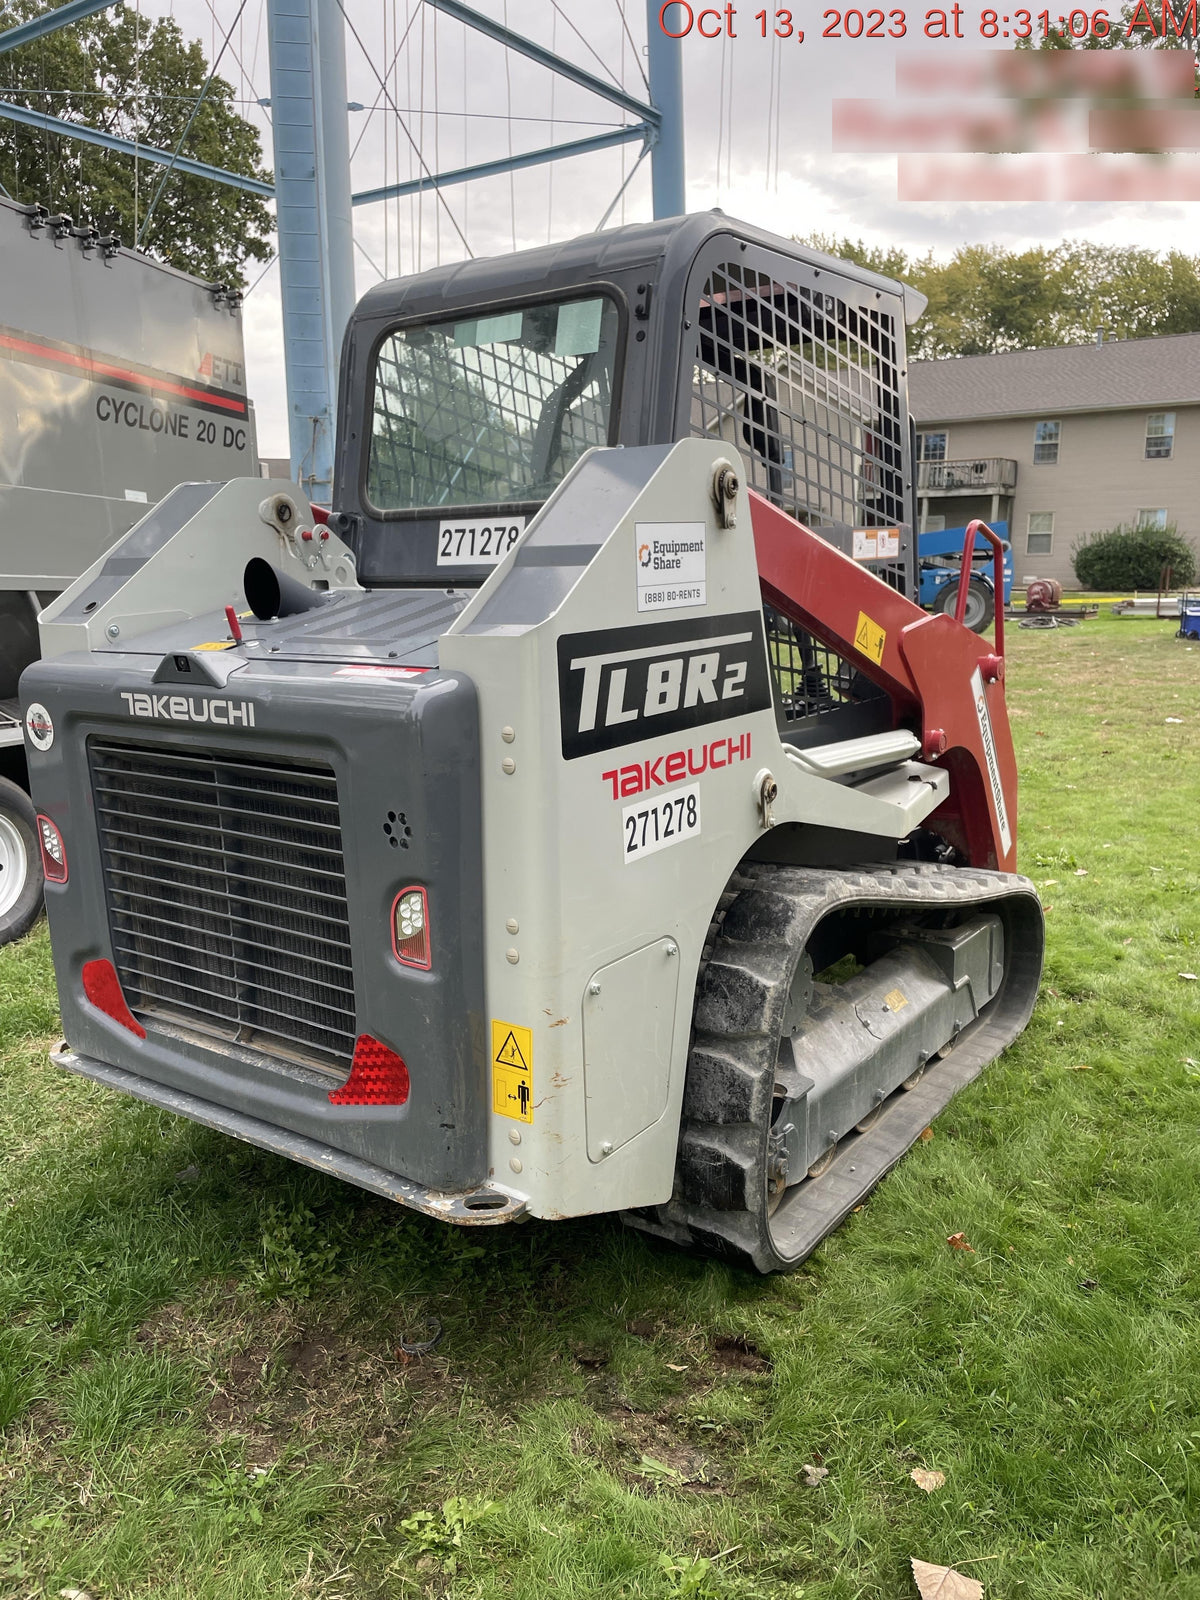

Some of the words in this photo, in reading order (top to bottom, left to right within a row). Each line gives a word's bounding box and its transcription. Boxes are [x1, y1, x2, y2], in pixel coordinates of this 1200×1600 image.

[96, 395, 189, 438] CYCLONE
[196, 419, 216, 444] 20
[223, 426, 246, 451] DC
[440, 526, 519, 557] 271278
[653, 540, 704, 556] Equipment
[653, 556, 681, 570] Share
[644, 592, 665, 604] (888)
[570, 631, 753, 734] TL8R2
[625, 794, 698, 853] 271278
